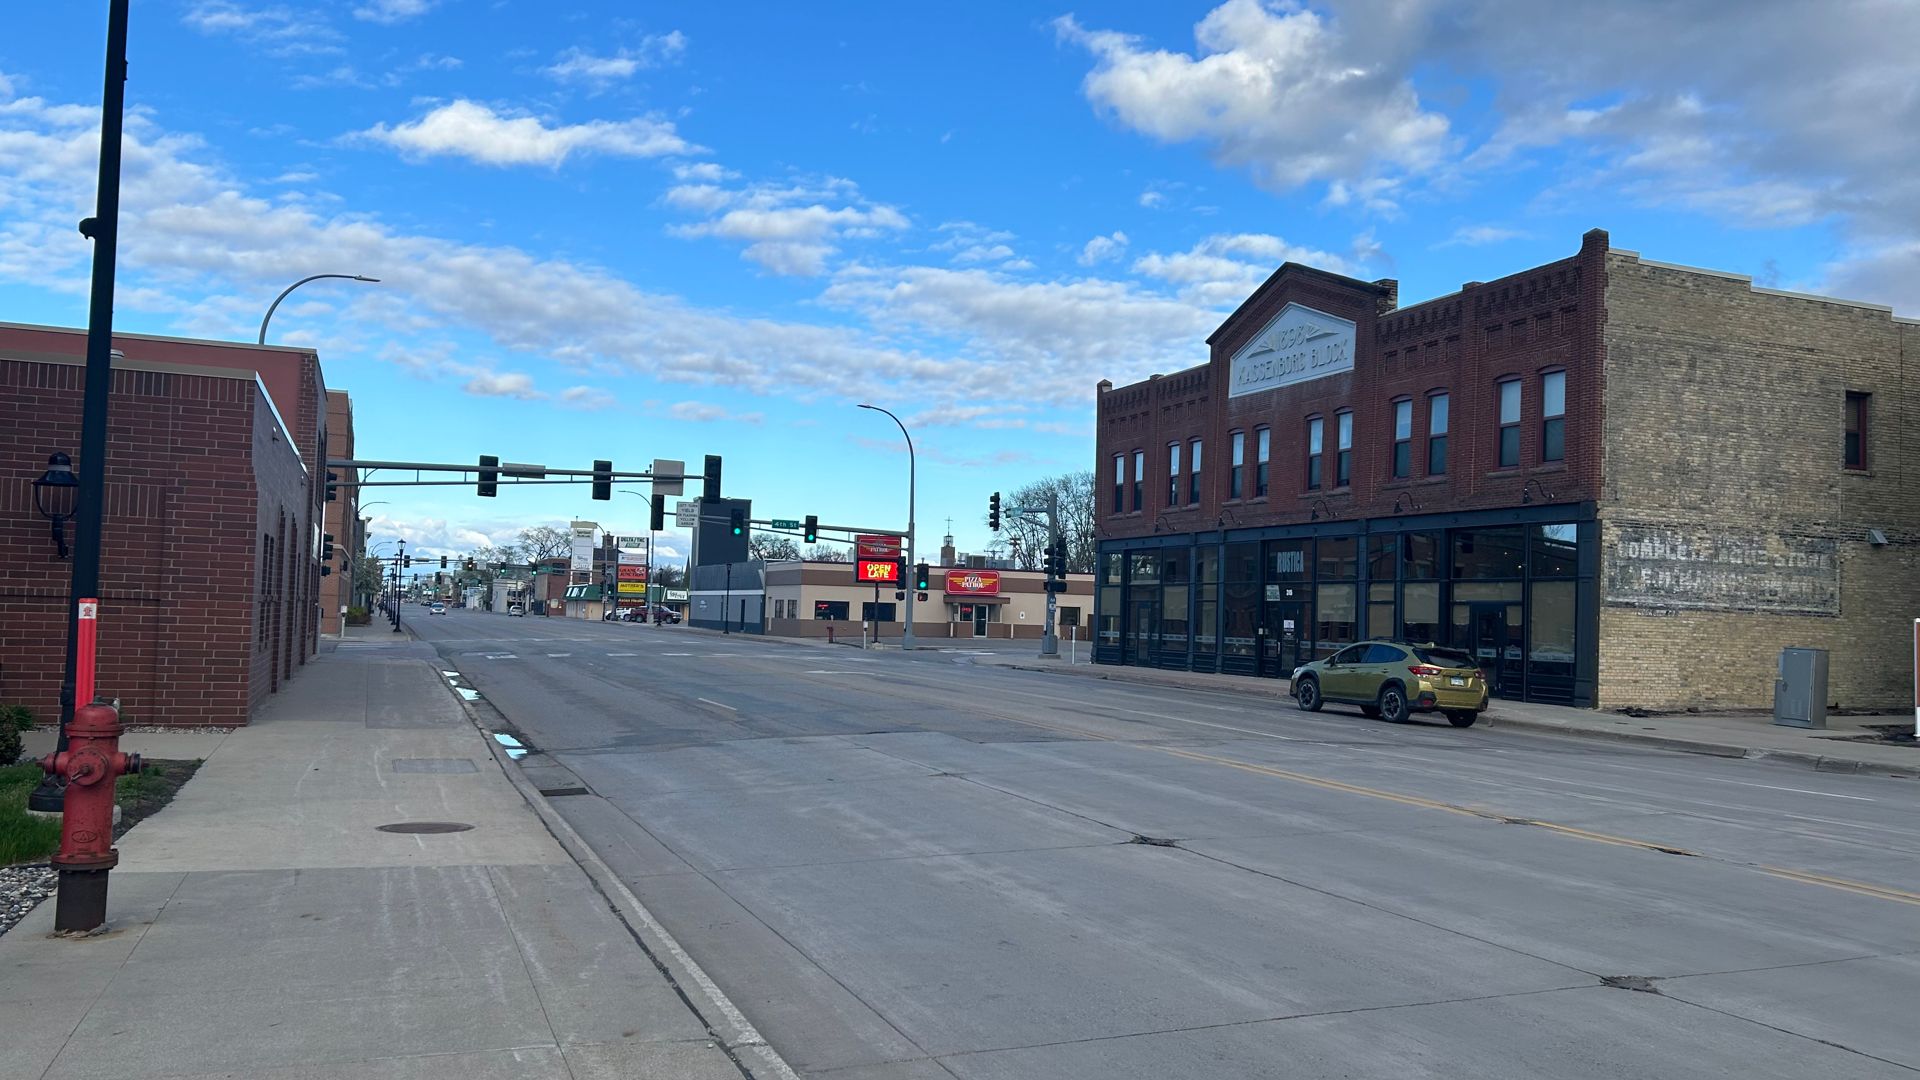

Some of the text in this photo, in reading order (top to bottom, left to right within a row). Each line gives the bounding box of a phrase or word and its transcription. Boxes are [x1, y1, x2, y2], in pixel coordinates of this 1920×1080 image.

[1237, 339, 1348, 386] KASSENBORG BLOCK
[867, 563, 891, 571] OPEN
[1277, 551, 1304, 573] RUSTICA
